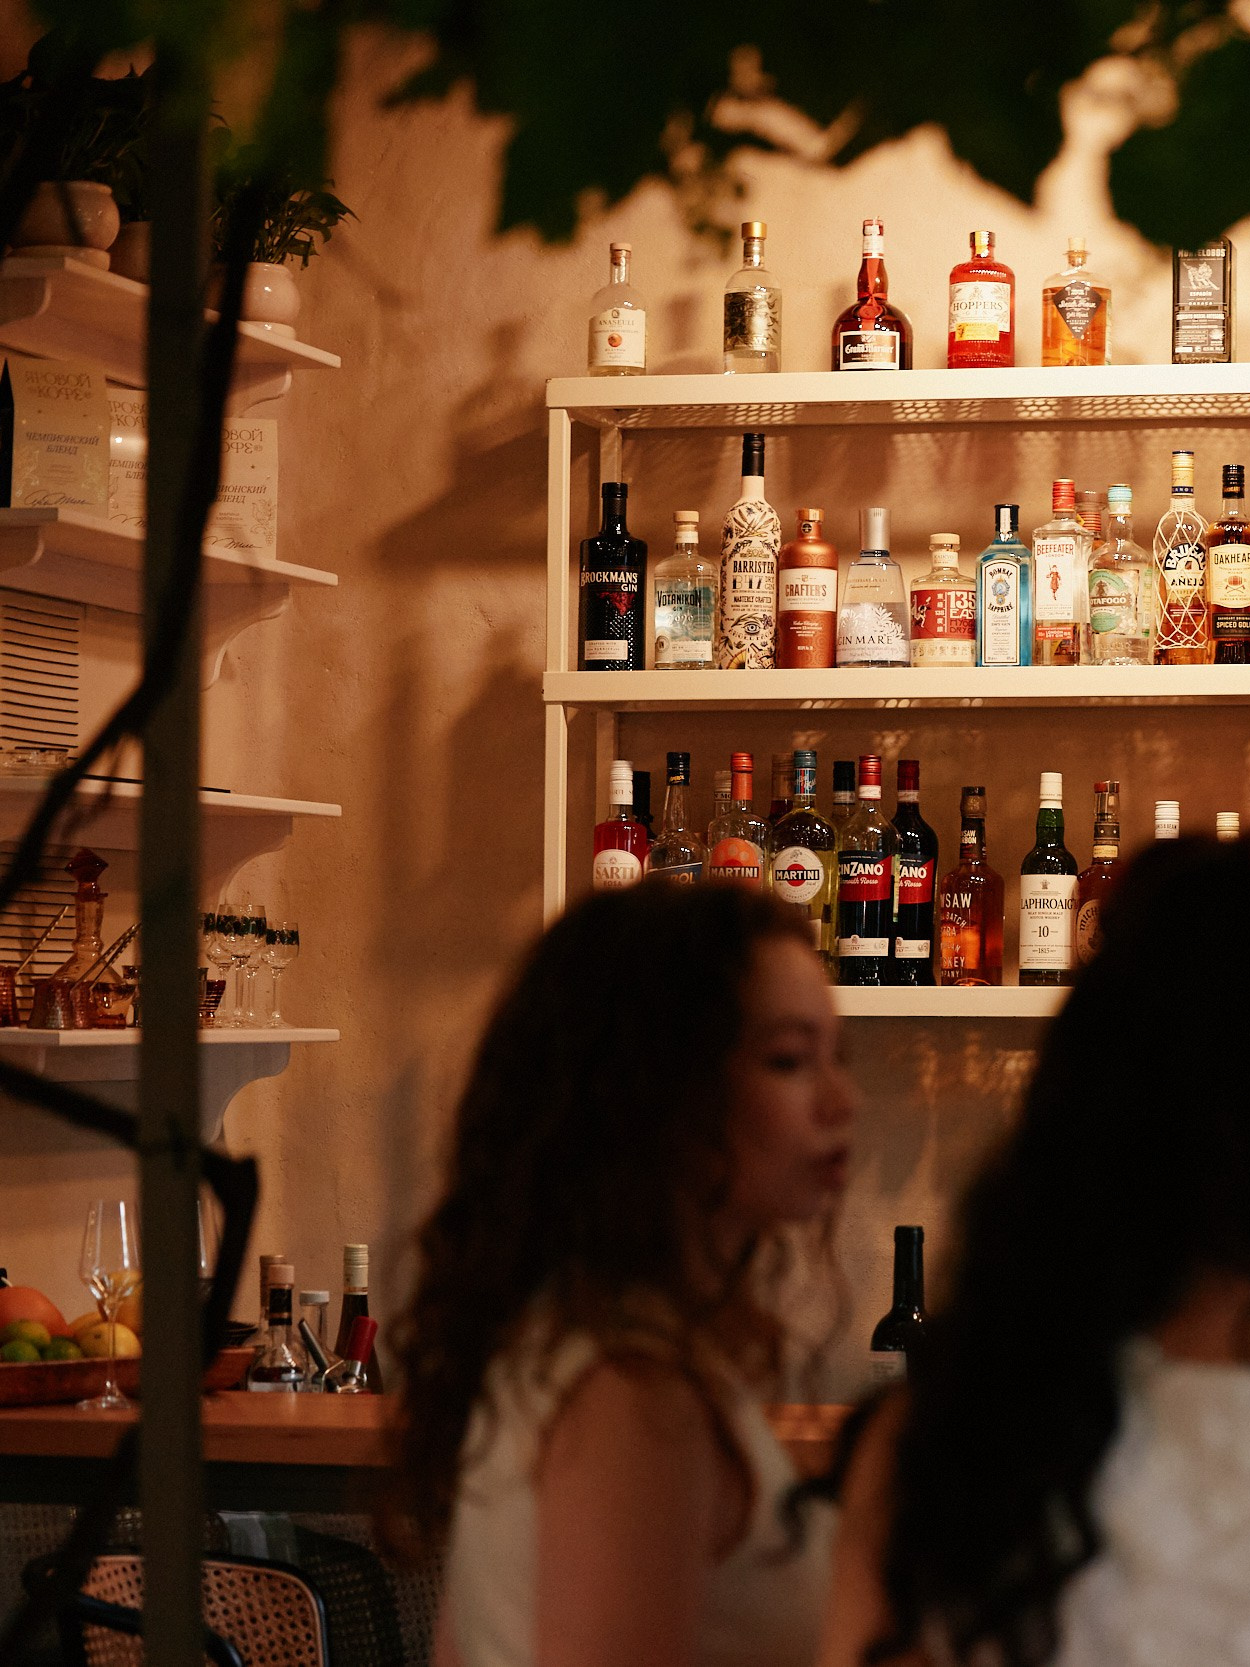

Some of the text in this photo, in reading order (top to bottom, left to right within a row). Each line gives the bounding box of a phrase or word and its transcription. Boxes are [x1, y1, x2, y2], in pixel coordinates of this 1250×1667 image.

[953, 301, 1003, 311] HOPPERS
[1037, 544, 1074, 556] BEEFEATER
[733, 560, 775, 575] BARRISTER
[581, 571, 638, 587] BROCKMANS
[1171, 575, 1204, 587] AÑEJO
[621, 584, 638, 593] GIN
[657, 590, 702, 609] VOTANIKON
[1216, 621, 1237, 629] SPICED
[855, 635, 893, 646] MARE
[596, 866, 634, 880] SARTI
[711, 866, 758, 878] MARTINI
[776, 870, 819, 880] MARTINI
[860, 876, 879, 886] Rosso
[1038, 925, 1049, 938] 10
